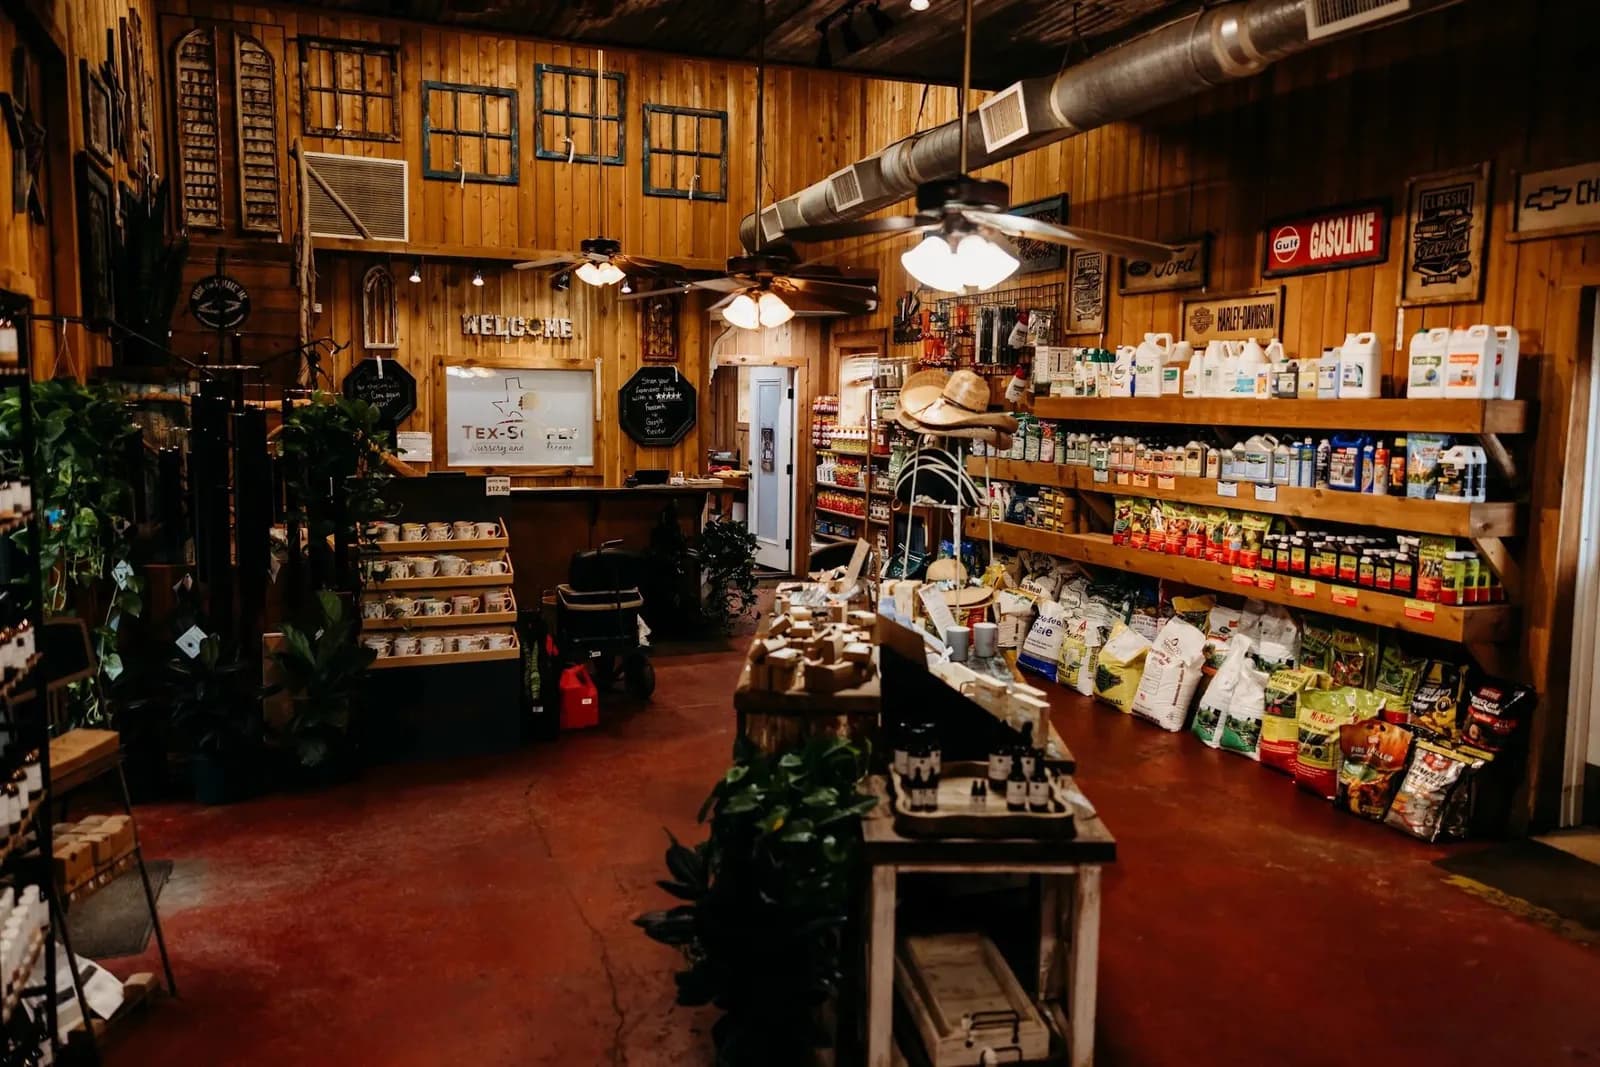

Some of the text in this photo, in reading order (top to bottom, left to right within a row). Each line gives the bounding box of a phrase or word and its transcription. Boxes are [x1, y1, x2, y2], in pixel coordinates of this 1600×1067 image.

[1424, 191, 1468, 210] CLASSIC
[1275, 238, 1299, 251] Gulf
[1309, 212, 1375, 260] GASOLINE
[1217, 303, 1275, 332] HARLEY-DAVIDSON
